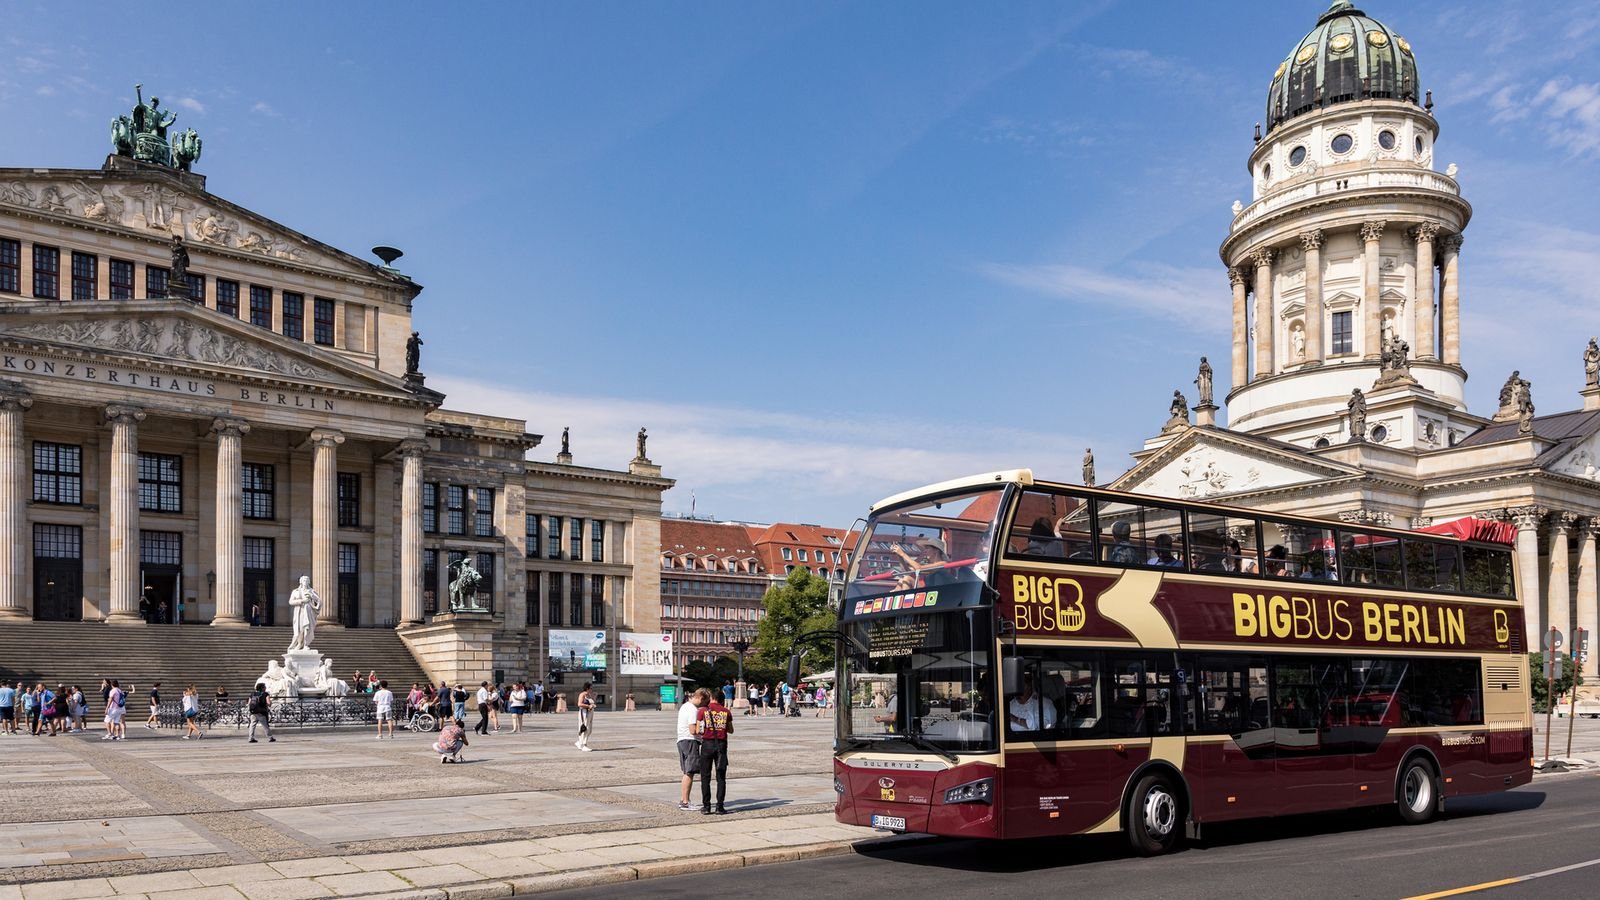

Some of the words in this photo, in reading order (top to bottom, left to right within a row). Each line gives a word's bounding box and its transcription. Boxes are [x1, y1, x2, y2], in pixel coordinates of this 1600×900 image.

[3, 355, 217, 396] KONZERTHAUS
[240, 388, 335, 411] BERLIN
[1012, 574, 1054, 604] BIG
[1014, 604, 1055, 631] BUS
[1362, 601, 1466, 645] BERLIN
[621, 648, 671, 666] EINBLICK
[1441, 735, 1486, 747] BIGBUSTOURS.COM
